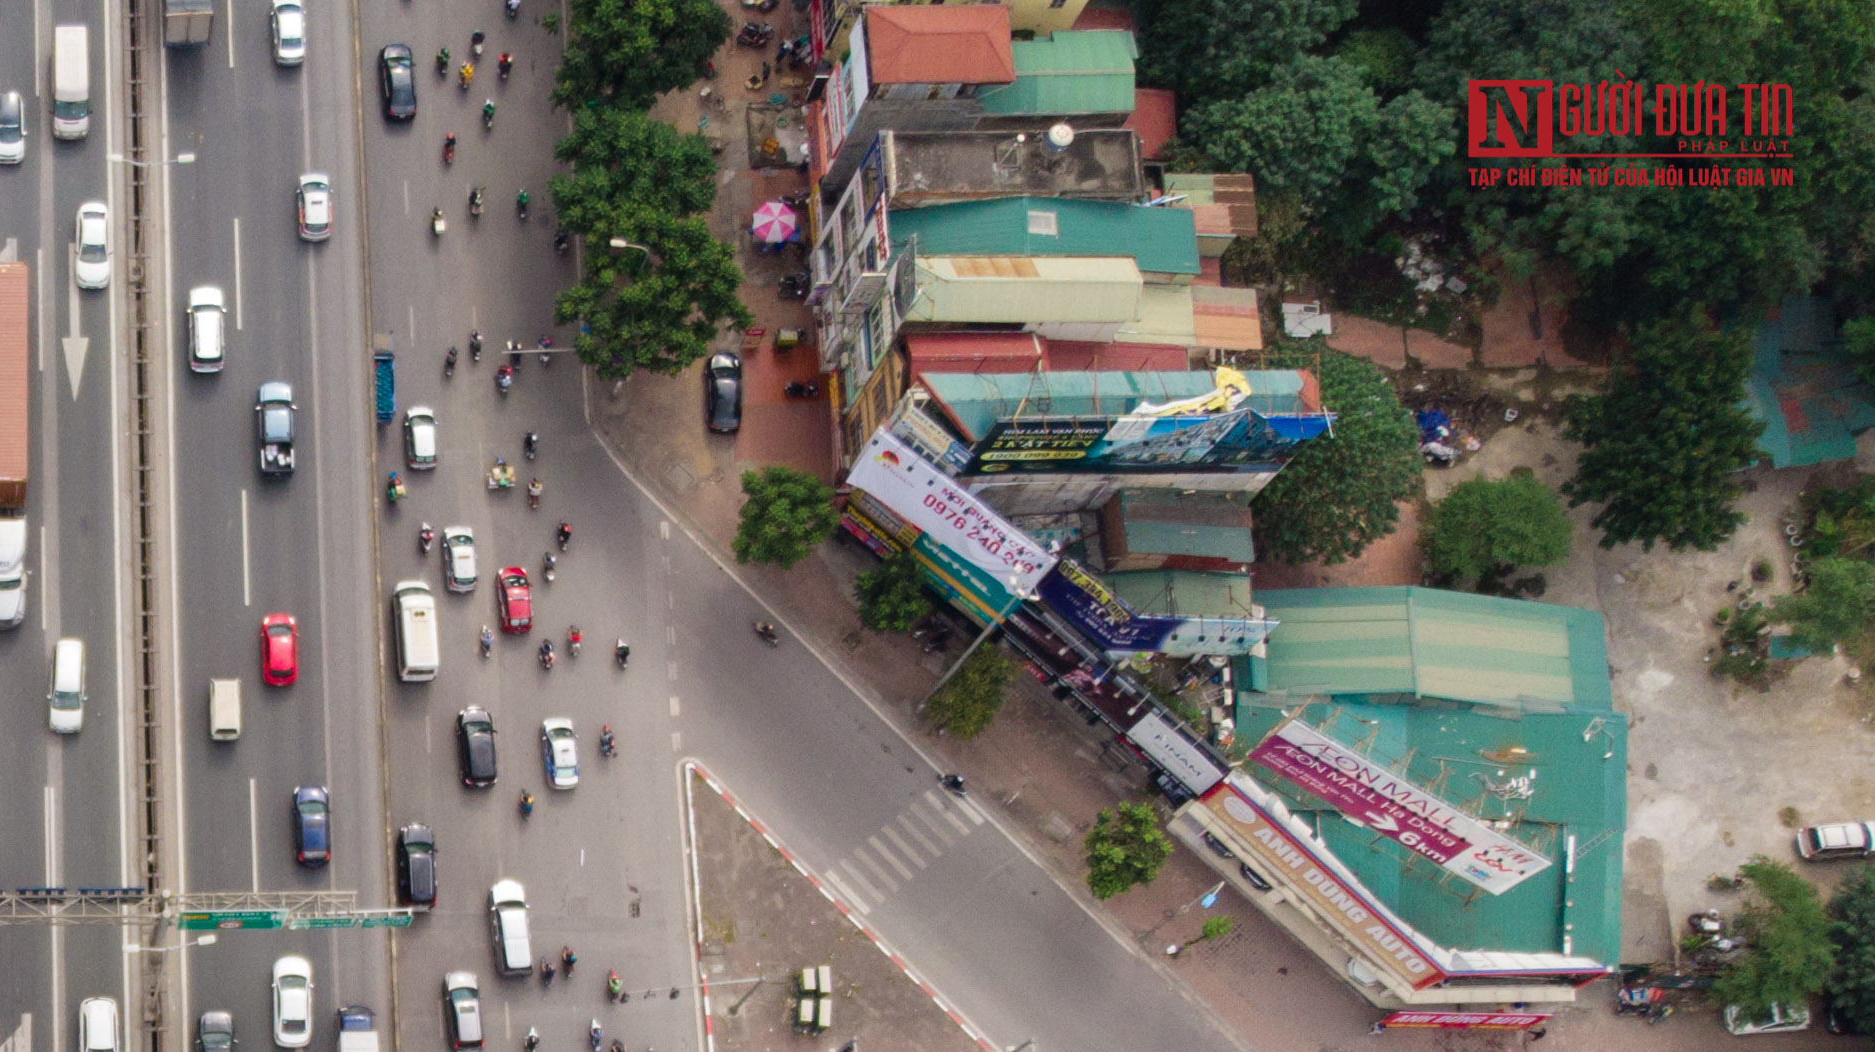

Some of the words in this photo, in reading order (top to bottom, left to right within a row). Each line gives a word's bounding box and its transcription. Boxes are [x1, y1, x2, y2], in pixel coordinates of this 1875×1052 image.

[923, 494, 965, 530] 0976
[967, 527, 1002, 555] 240
[1327, 769, 1377, 805] MALL
[1383, 782, 1459, 830] MALL
[1253, 827, 1306, 870] ANH
[1365, 920, 1425, 974] AUTO
[1392, 1014, 1434, 1023] ANH
[1485, 1015, 1537, 1025] AUTO
